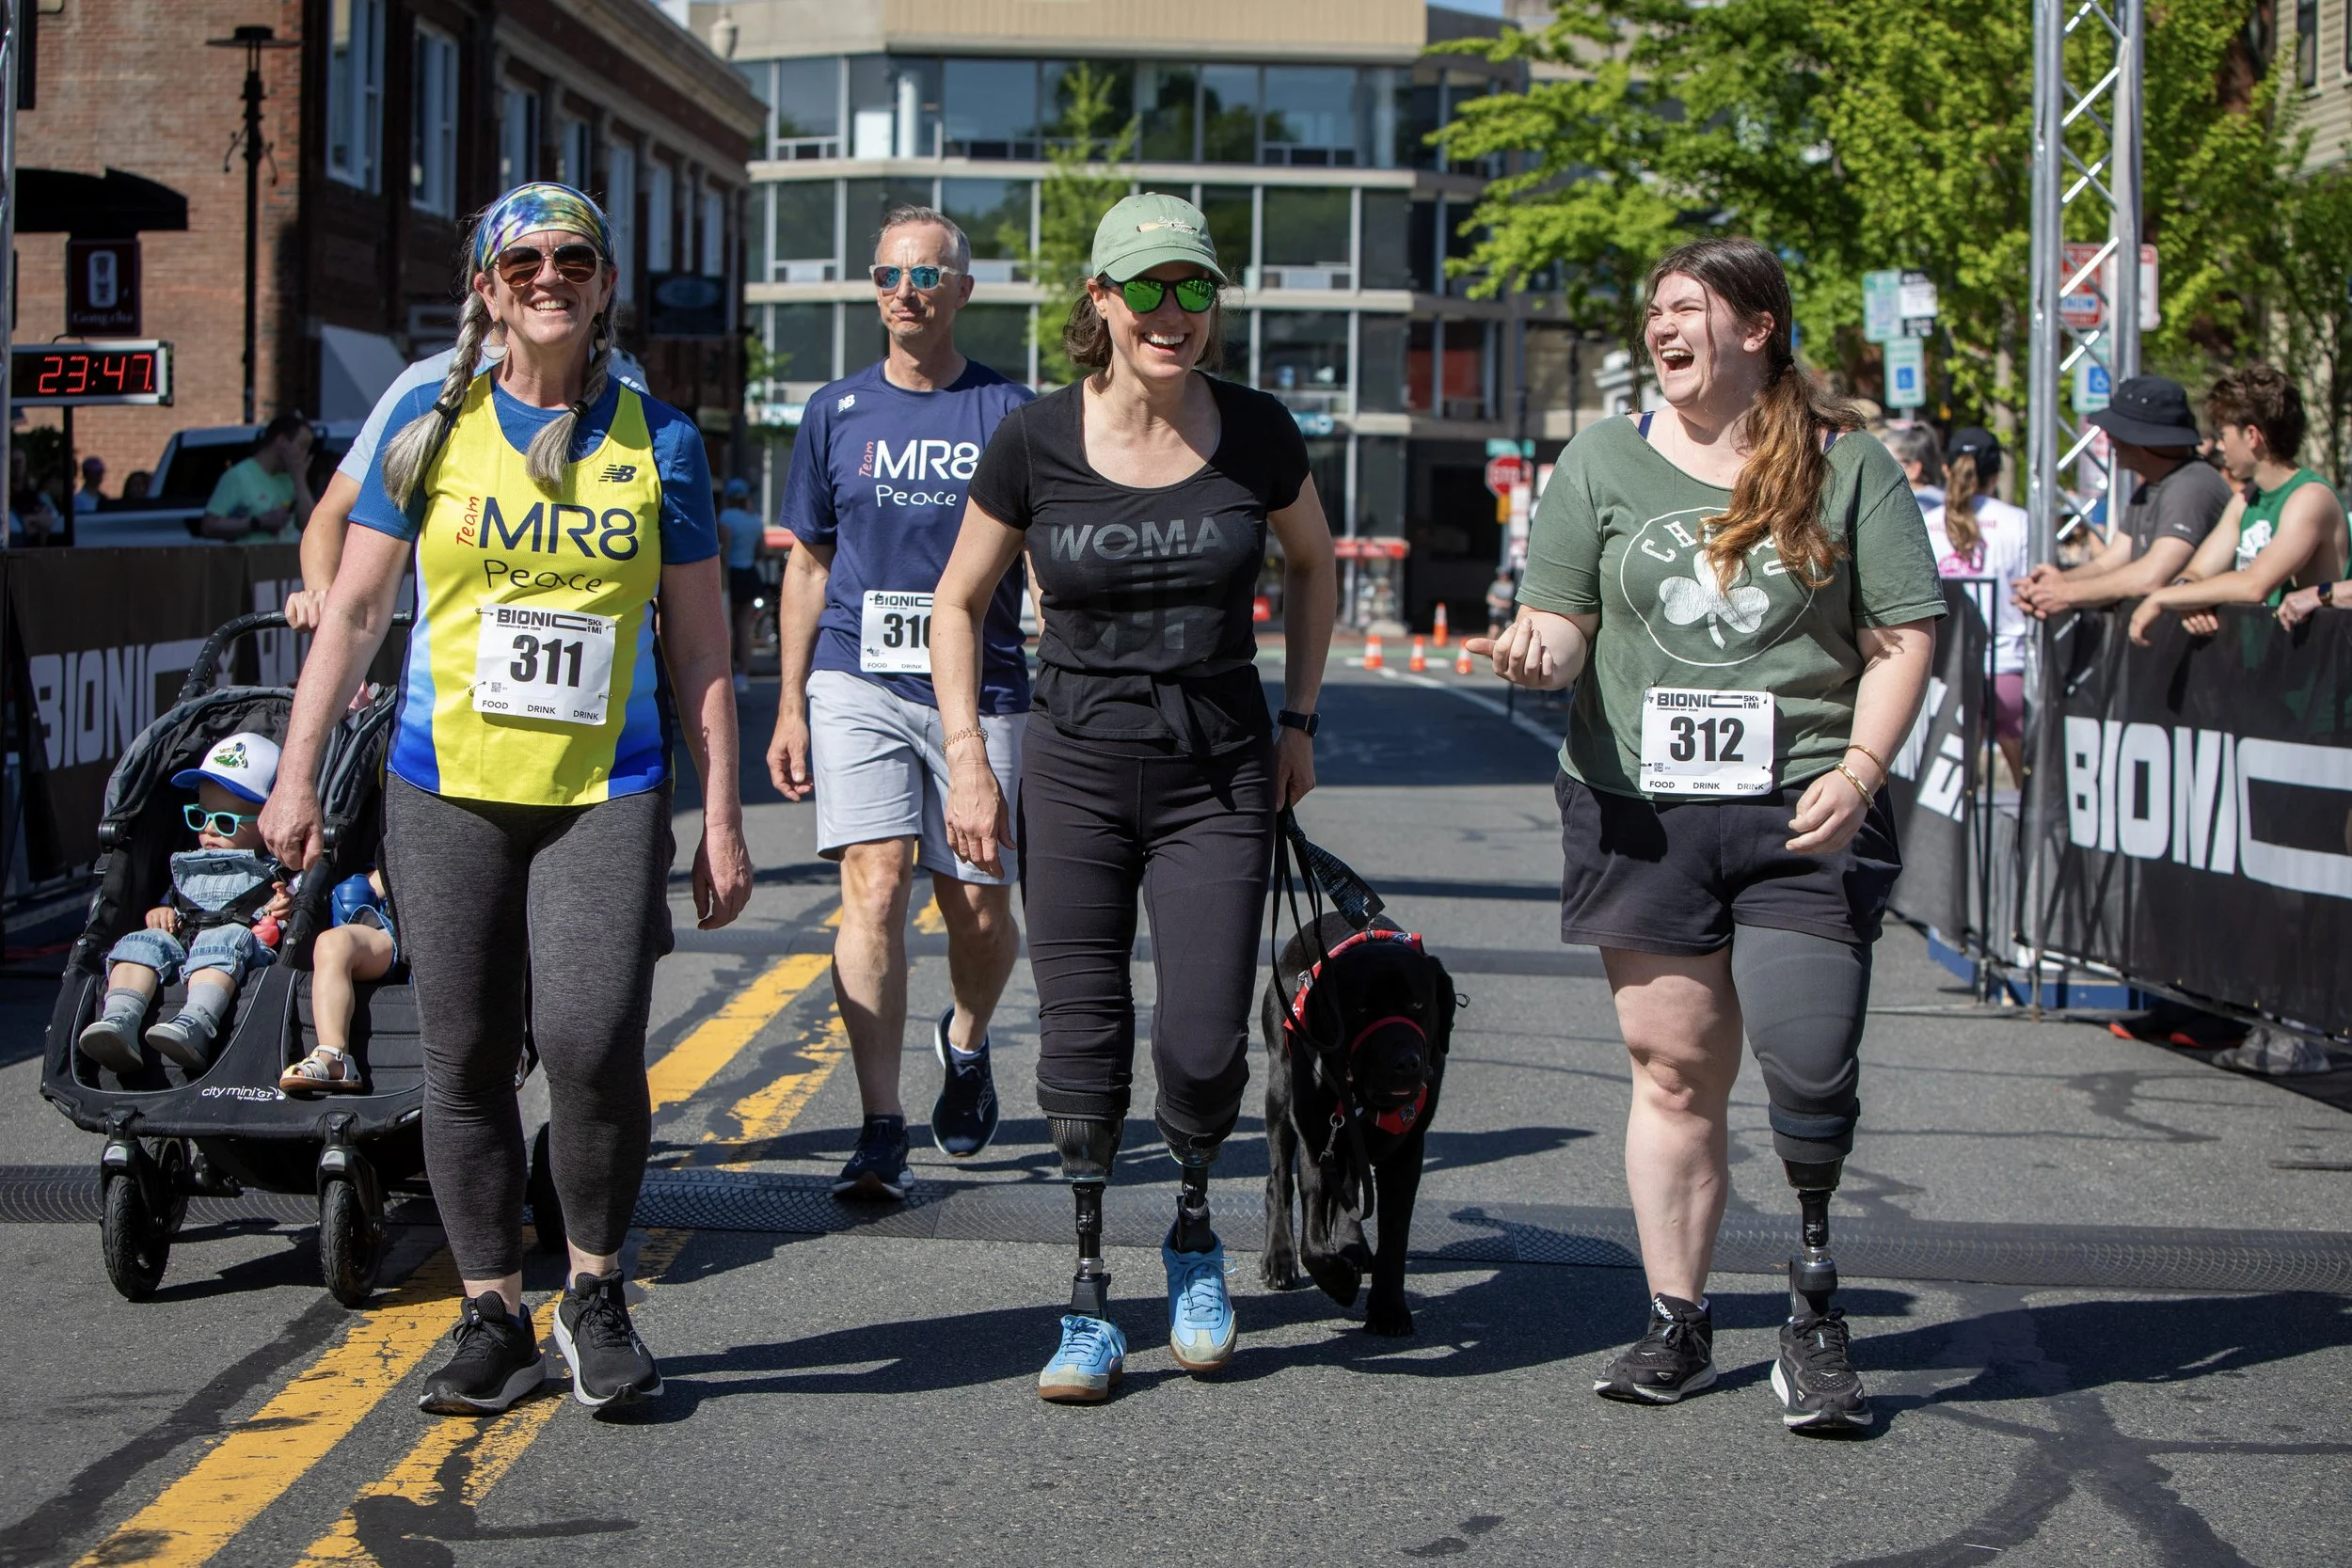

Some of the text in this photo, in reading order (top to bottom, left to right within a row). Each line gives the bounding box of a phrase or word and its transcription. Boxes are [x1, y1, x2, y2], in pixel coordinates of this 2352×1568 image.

[858, 440, 874, 478] Team
[873, 439, 979, 481] MR8
[876, 484, 957, 508] Peace
[455, 496, 480, 547] Team
[479, 496, 639, 562] MR8
[1050, 516, 1229, 562] WOMA
[484, 559, 602, 594] Peace
[497, 609, 588, 632] BIONIC
[510, 634, 583, 689] 311
[482, 700, 598, 721] FOOD DRINK DRINK
[1657, 692, 1742, 708] BIONIC
[1670, 716, 1744, 762] 312
[1649, 781, 1675, 789] FOOD
[2064, 715, 2352, 900] BIONIC
[201, 1085, 226, 1099] city
[226, 1085, 257, 1097] mini
